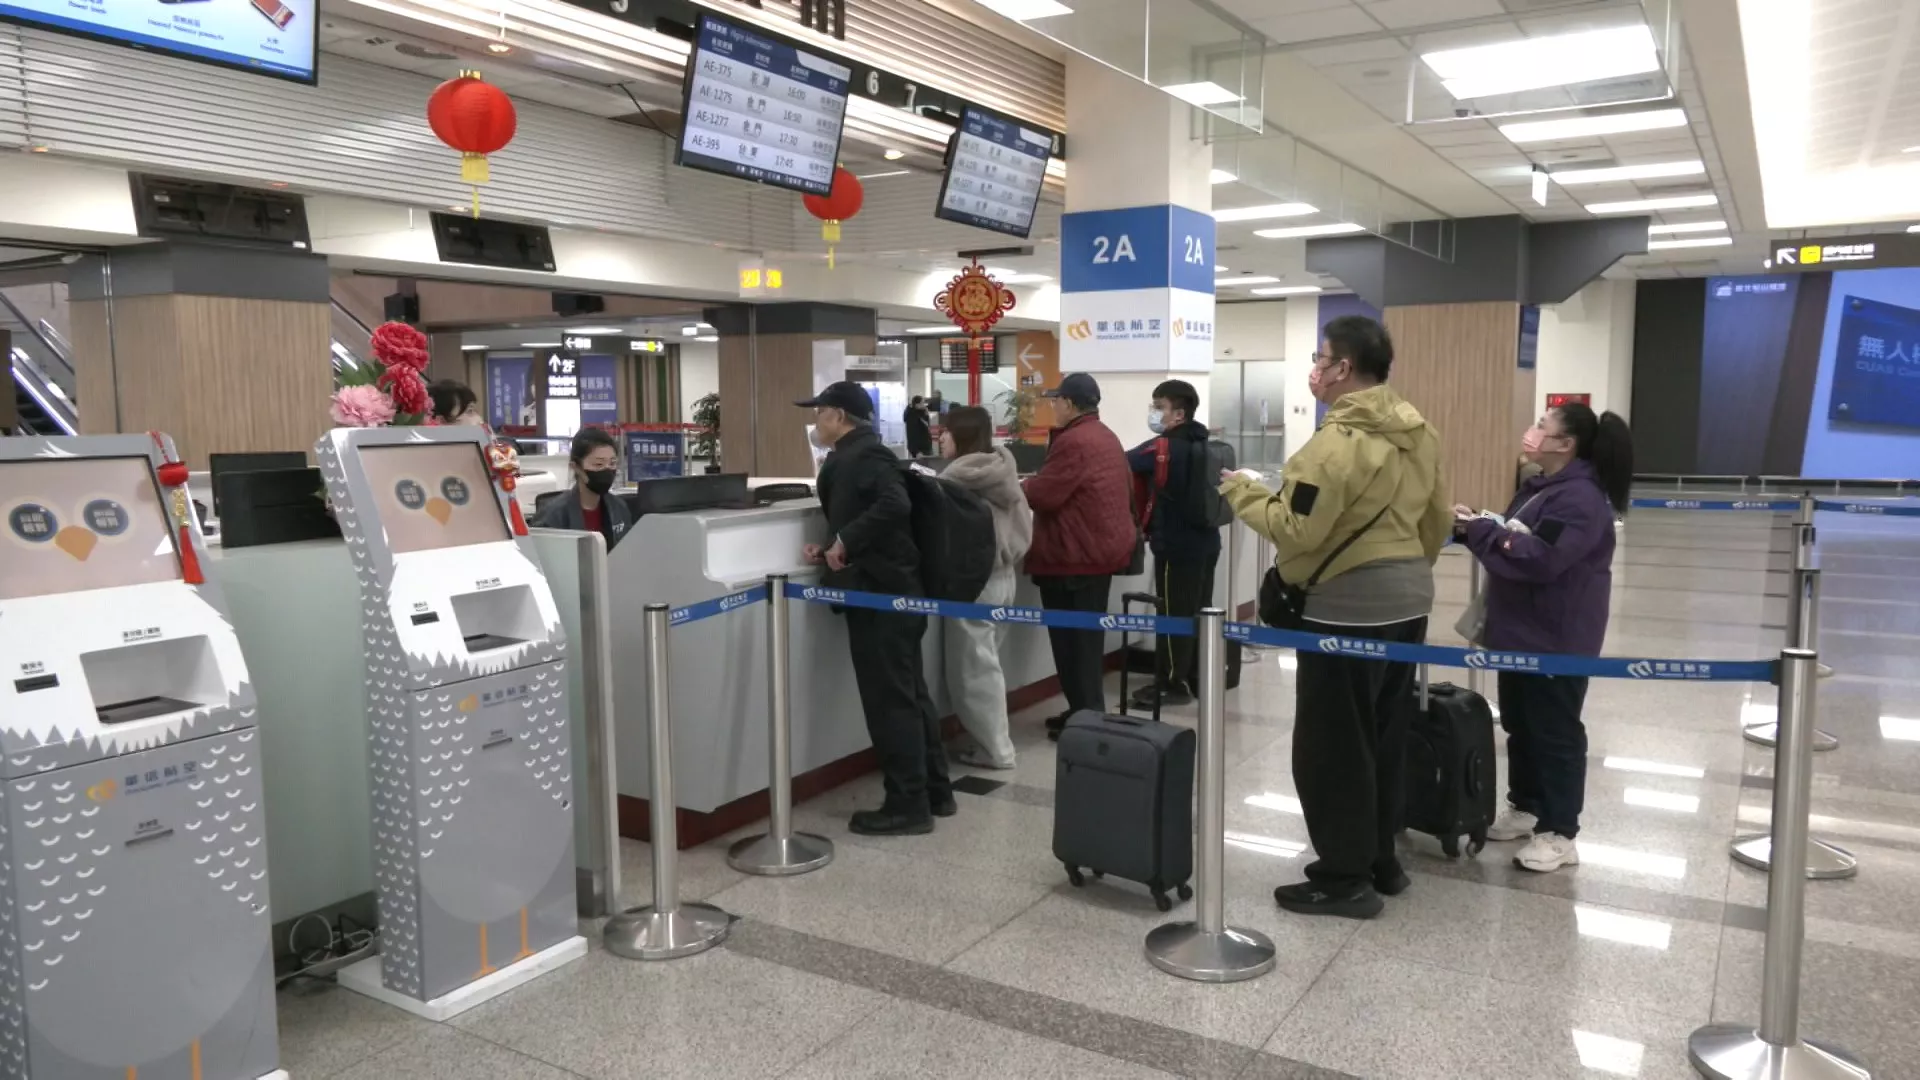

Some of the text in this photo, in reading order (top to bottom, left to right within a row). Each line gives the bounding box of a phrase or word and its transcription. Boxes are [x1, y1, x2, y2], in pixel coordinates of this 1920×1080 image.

[703, 59, 733, 78] AE-375
[866, 70, 879, 95] 6
[700, 84, 733, 104] AE-1275
[905, 83, 917, 113] 7
[695, 109, 729, 127] AE-1277
[691, 134, 720, 151] AE-395
[1051, 134, 1060, 154] 8
[1092, 234, 1136, 264] 2A
[1184, 234, 1204, 266] 2A
[562, 359, 575, 373] 2F
